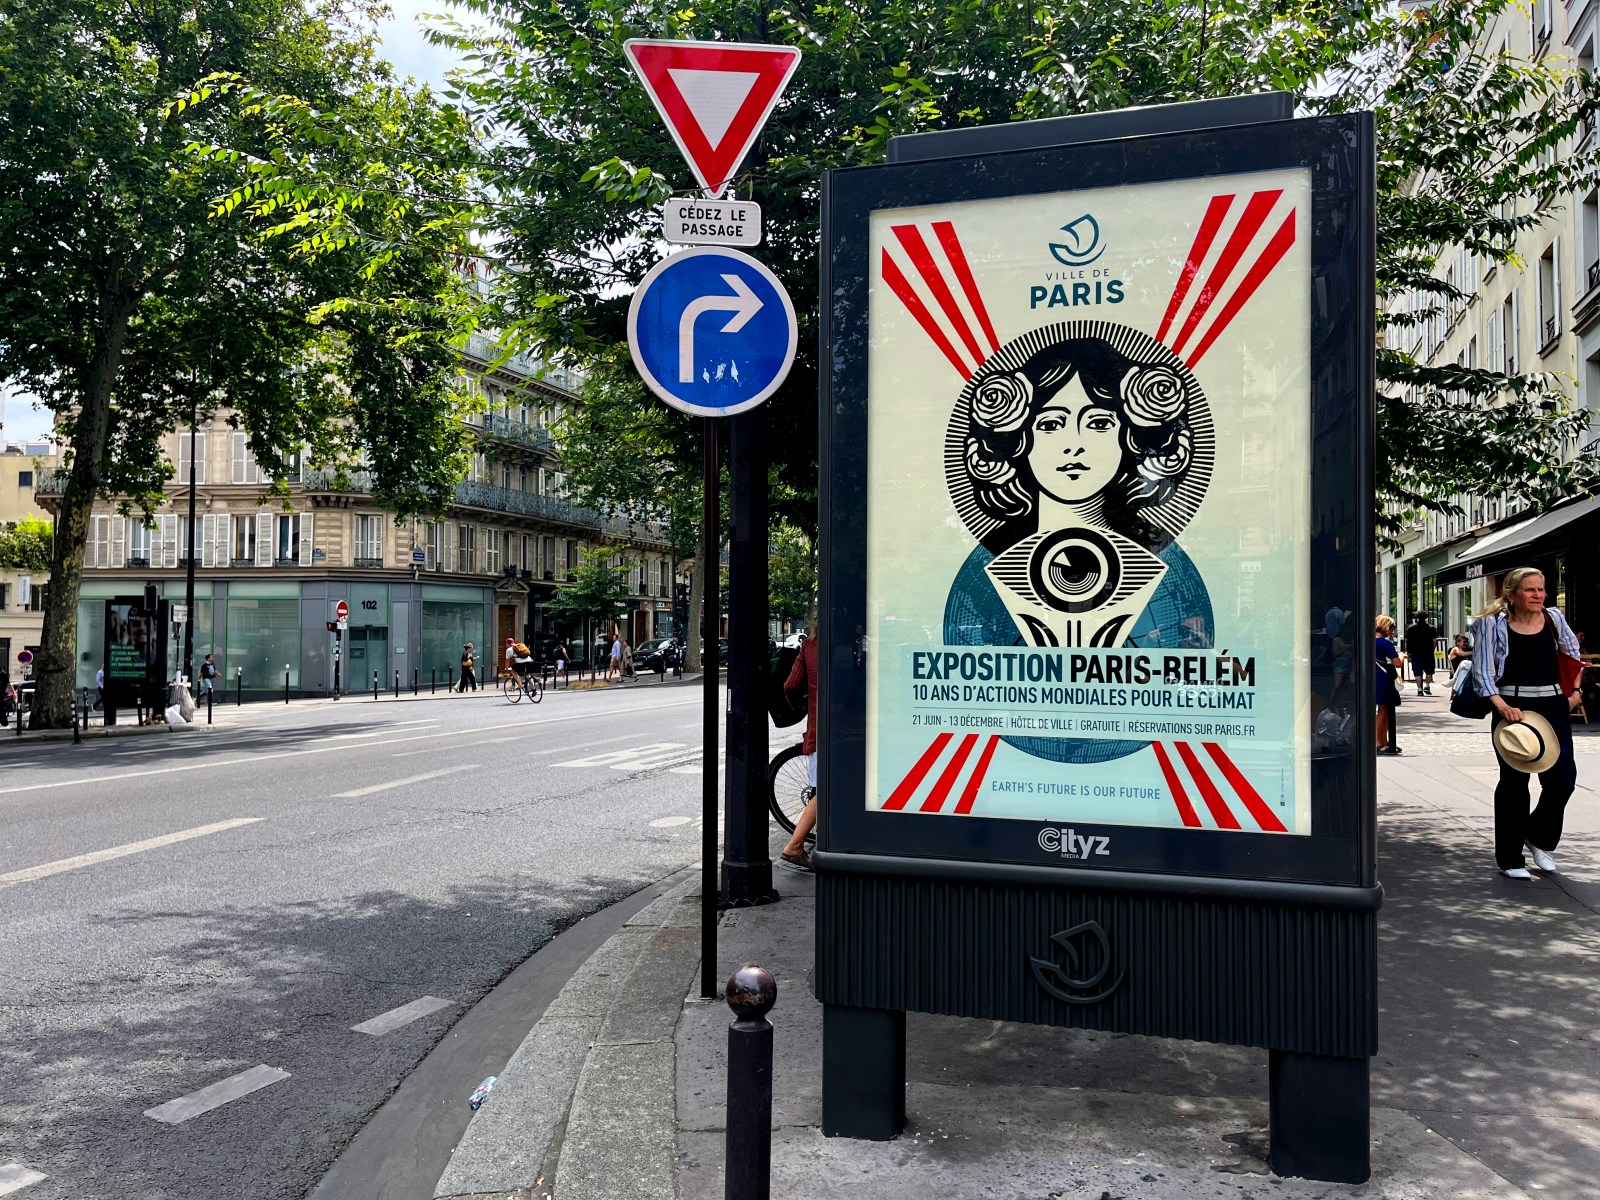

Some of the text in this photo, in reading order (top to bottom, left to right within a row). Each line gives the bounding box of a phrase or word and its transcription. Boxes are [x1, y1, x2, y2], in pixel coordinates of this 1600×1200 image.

[679, 206, 746, 221] CÉDEZ LE
[682, 223, 743, 236] PASSAGE
[1046, 269, 1109, 280] VILLE DE
[1031, 280, 1125, 309] PARIS
[361, 600, 377, 610] 102
[912, 649, 1255, 687] EXPOSITION PARIS-BELÉM
[913, 684, 1255, 709] 10 ANS D'ACTIONS MONDIALES POUR LE CLIMAT
[912, 714, 921, 725] 21
[923, 715, 942, 726] JUIN
[949, 716, 958, 726] 13
[960, 714, 1004, 728] DÉCEMBRE
[1011, 716, 1036, 729] HÔTEL
[1038, 718, 1049, 729] DE
[1050, 718, 1073, 730] VILLE
[1080, 720, 1120, 732] GRATUITE
[1128, 719, 1192, 734] RÉSERVATIONS
[1194, 724, 1212, 735] SUR
[1215, 724, 1255, 736] PARIS.FR
[992, 781, 1160, 799] EARTH'S FUTURE IS OUR FUTURE
[1037, 827, 1110, 859] Cityz
